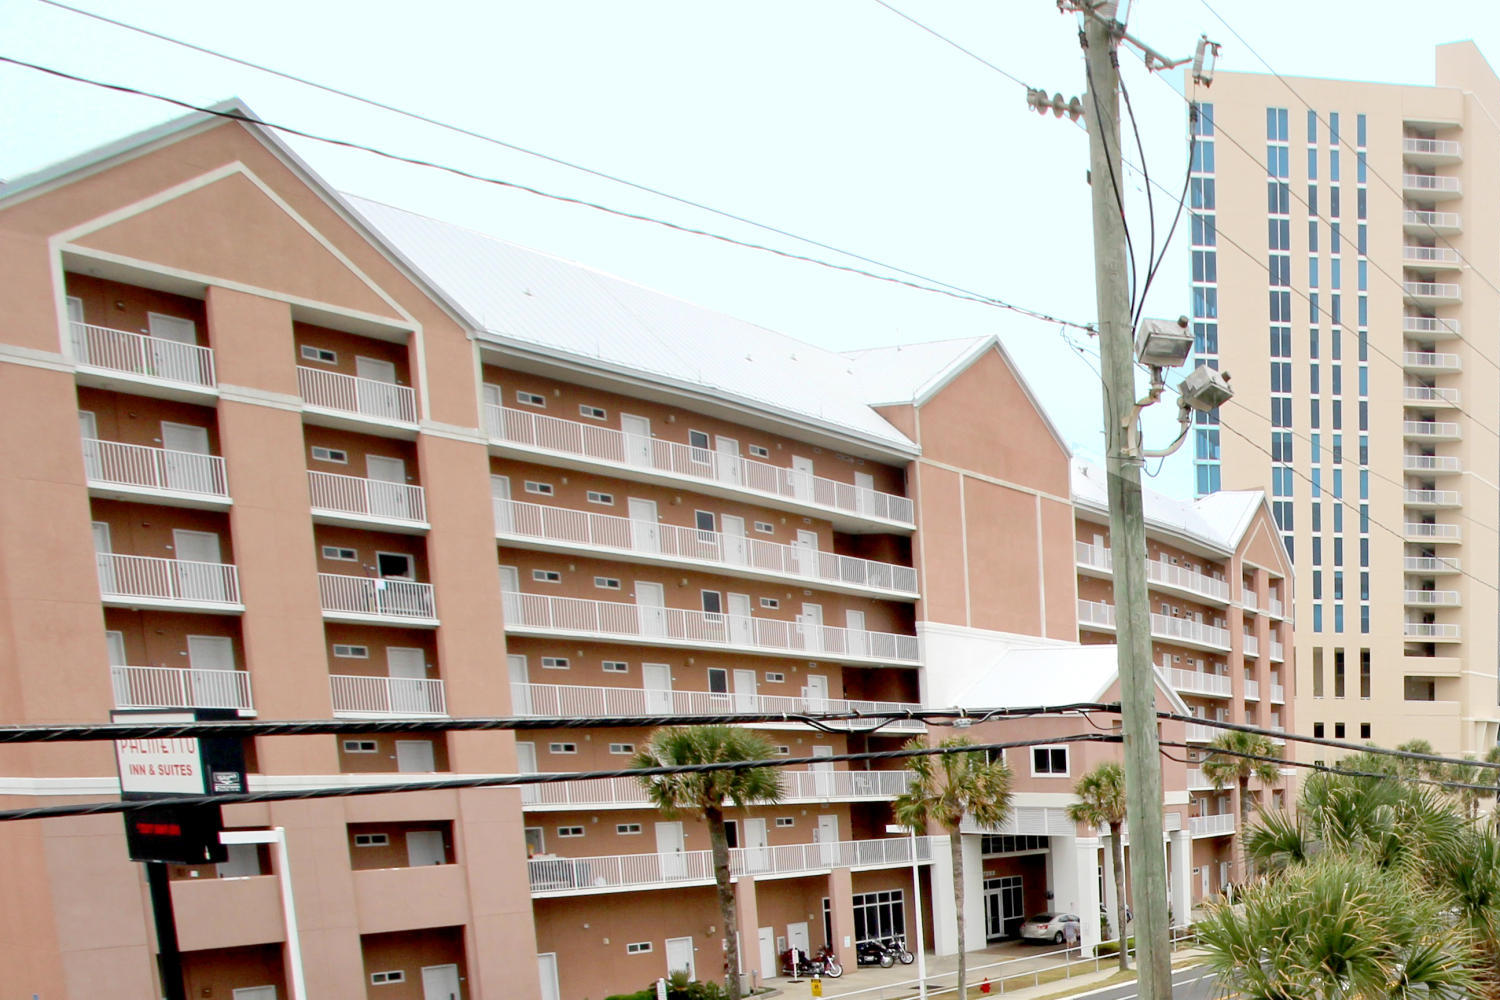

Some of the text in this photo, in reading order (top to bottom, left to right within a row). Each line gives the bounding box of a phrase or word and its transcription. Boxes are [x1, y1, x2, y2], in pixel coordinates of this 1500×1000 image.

[129, 763, 193, 776] INN & SUITES
